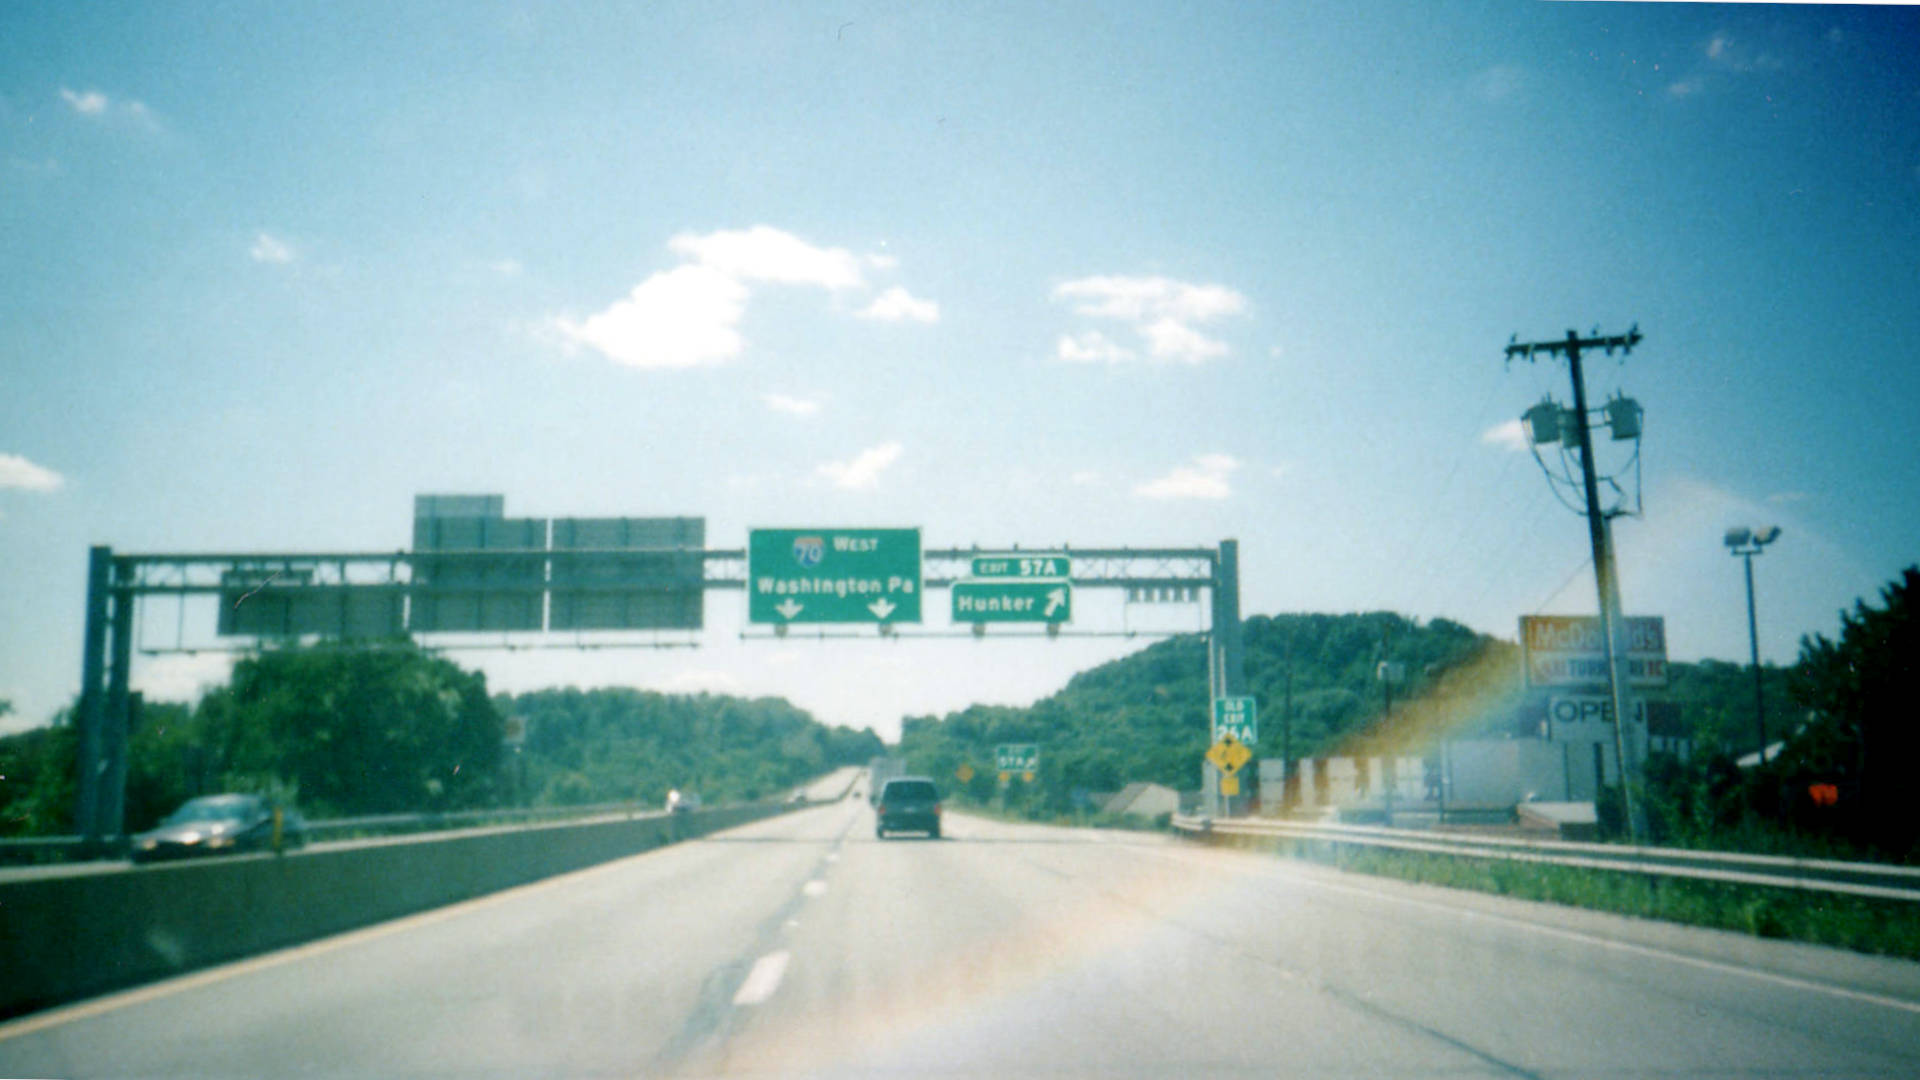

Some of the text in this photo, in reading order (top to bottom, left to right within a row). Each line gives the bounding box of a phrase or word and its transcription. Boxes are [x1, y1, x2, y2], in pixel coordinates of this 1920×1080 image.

[833, 536, 878, 551] WEST
[800, 544, 820, 561] 70
[1020, 559, 1057, 576] 57A
[757, 576, 914, 598] Washington Pa
[958, 594, 1034, 612] Hunker
